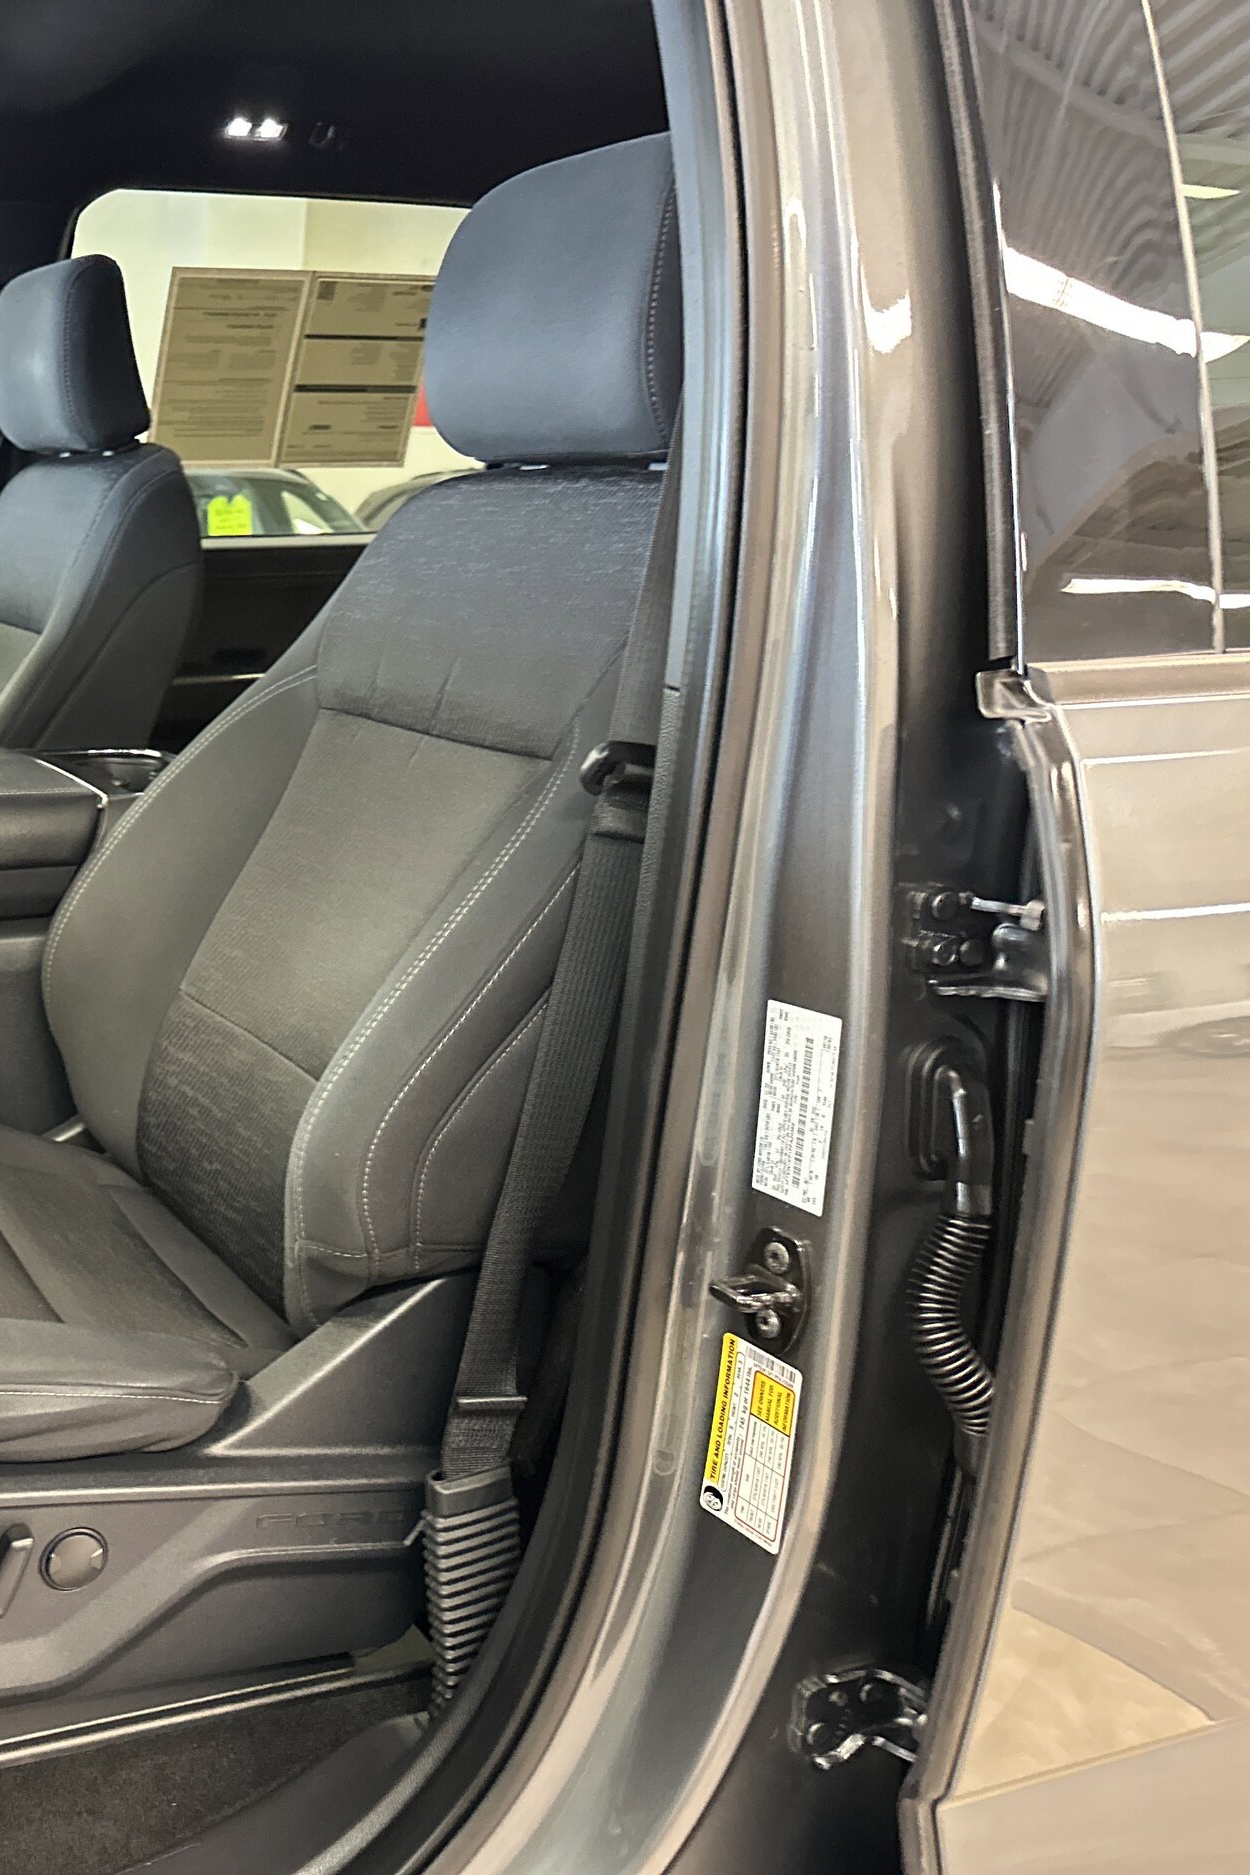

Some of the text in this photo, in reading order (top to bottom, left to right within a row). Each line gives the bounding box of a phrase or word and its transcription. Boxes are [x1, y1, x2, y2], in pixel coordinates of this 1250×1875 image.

[716, 1399, 726, 1439] LOADING
[722, 1337, 735, 1399] INFORMATION
[743, 1396, 748, 1404] or
[741, 1404, 748, 1415] kg
[764, 1397, 772, 1422] MANUAL
[772, 1389, 782, 1425] ADDITIONAL
